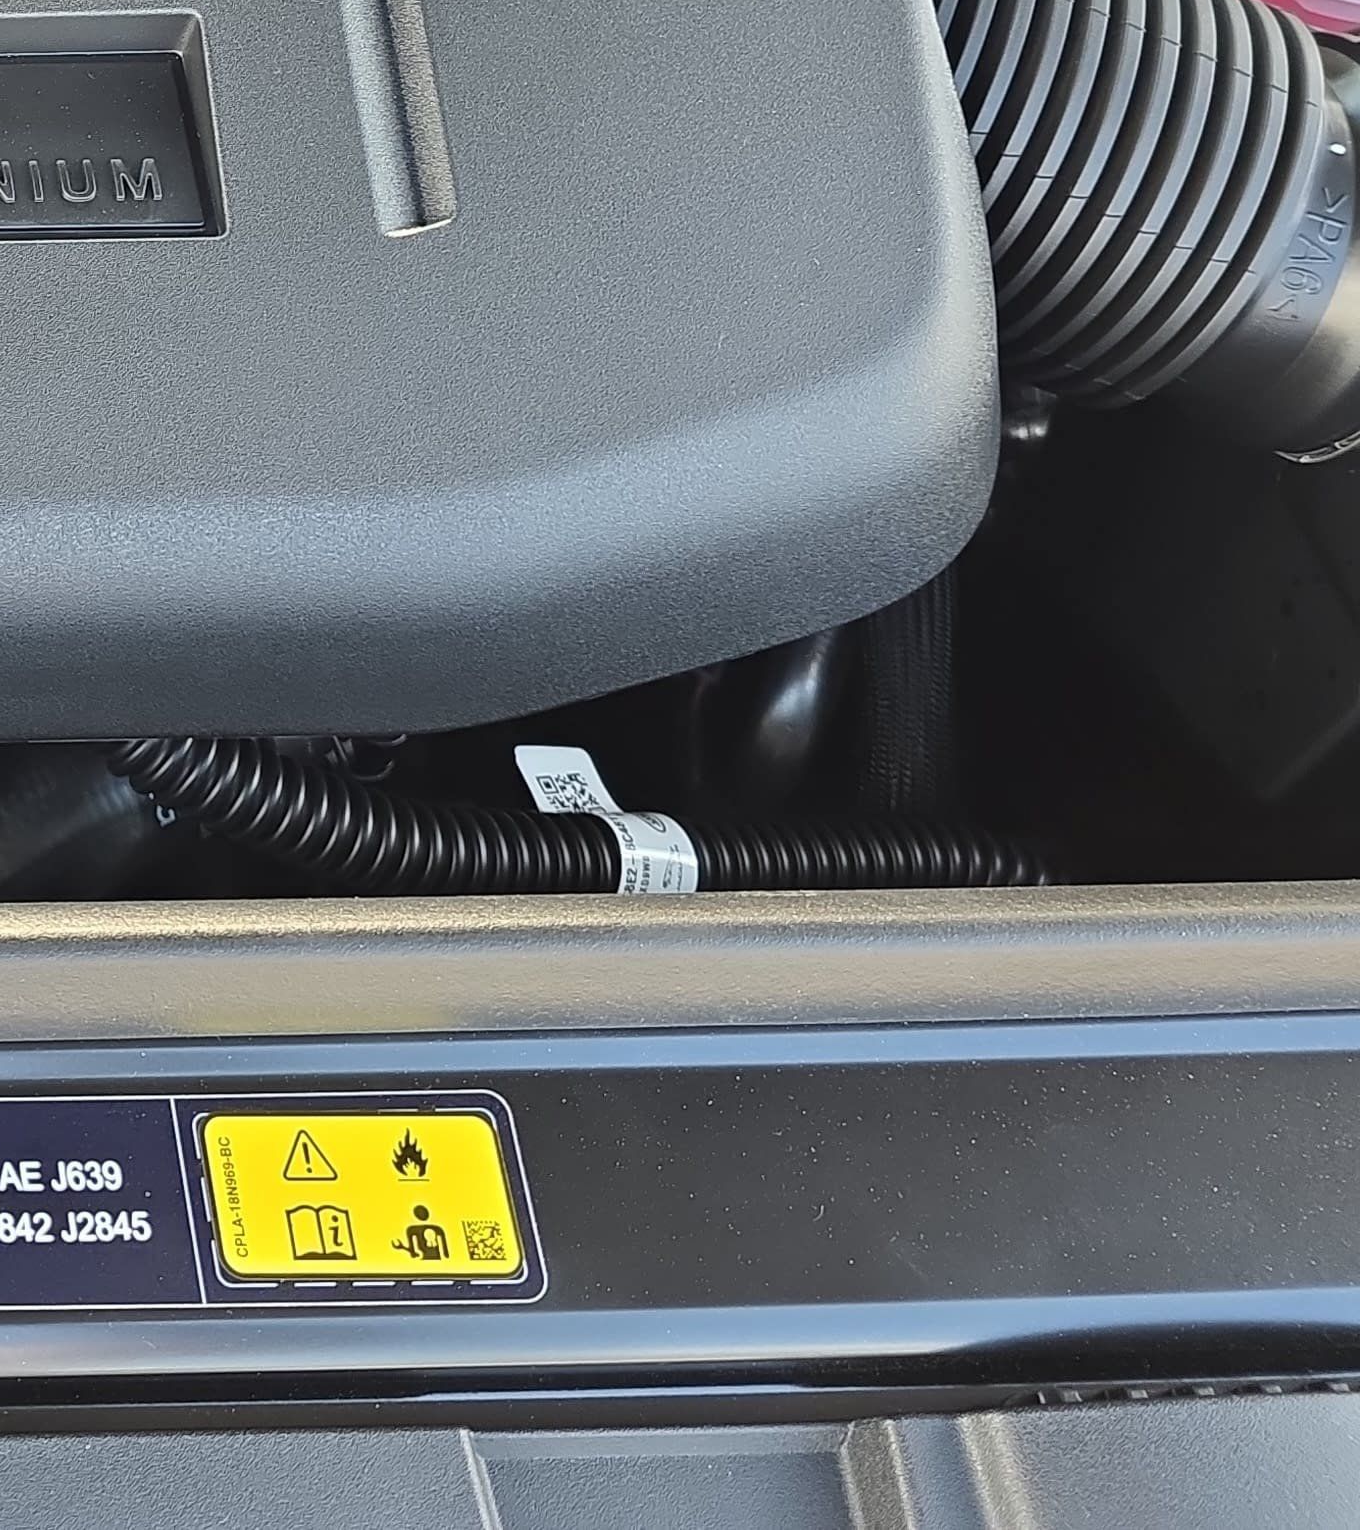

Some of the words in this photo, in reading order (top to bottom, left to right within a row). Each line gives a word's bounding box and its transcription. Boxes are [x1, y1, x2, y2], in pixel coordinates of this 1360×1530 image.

[50, 1159, 123, 1192] J639
[217, 1136, 249, 1258] CPLA-18N969-BC
[60, 1210, 153, 1243] J2845
